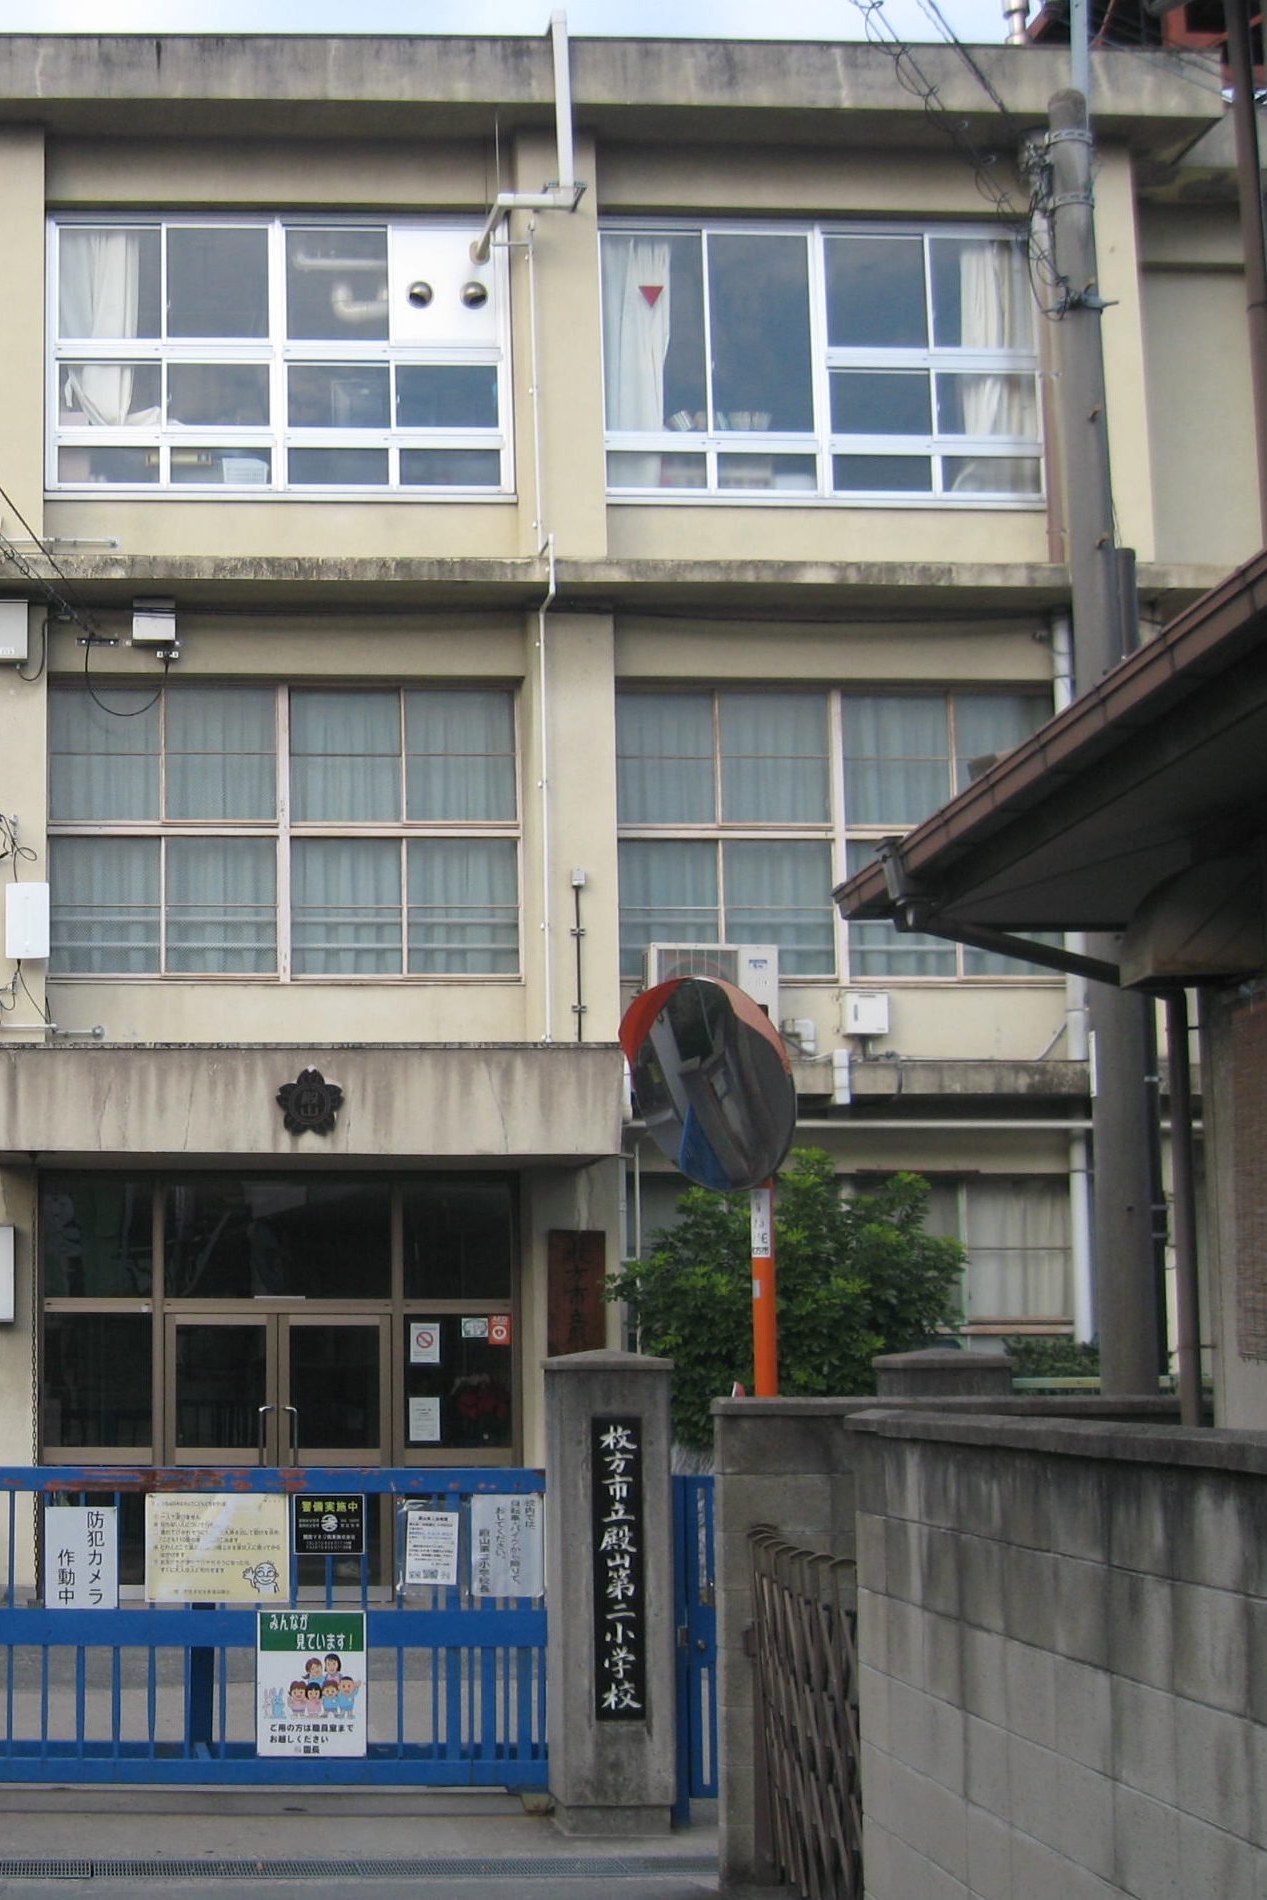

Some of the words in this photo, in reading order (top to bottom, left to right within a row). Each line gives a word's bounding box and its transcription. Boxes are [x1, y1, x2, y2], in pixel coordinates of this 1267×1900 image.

[301, 1500, 358, 1512] 警備実施中
[87, 1510, 105, 1605] 防犯カメラ
[57, 1548, 75, 1605] 作動中
[599, 1425, 643, 1710] 枚方市立殿山第二小学校
[269, 1613, 309, 1631] みんなが
[269, 1723, 354, 1733] ご用の方は職員室まで
[269, 1736, 329, 1744] お越しください
